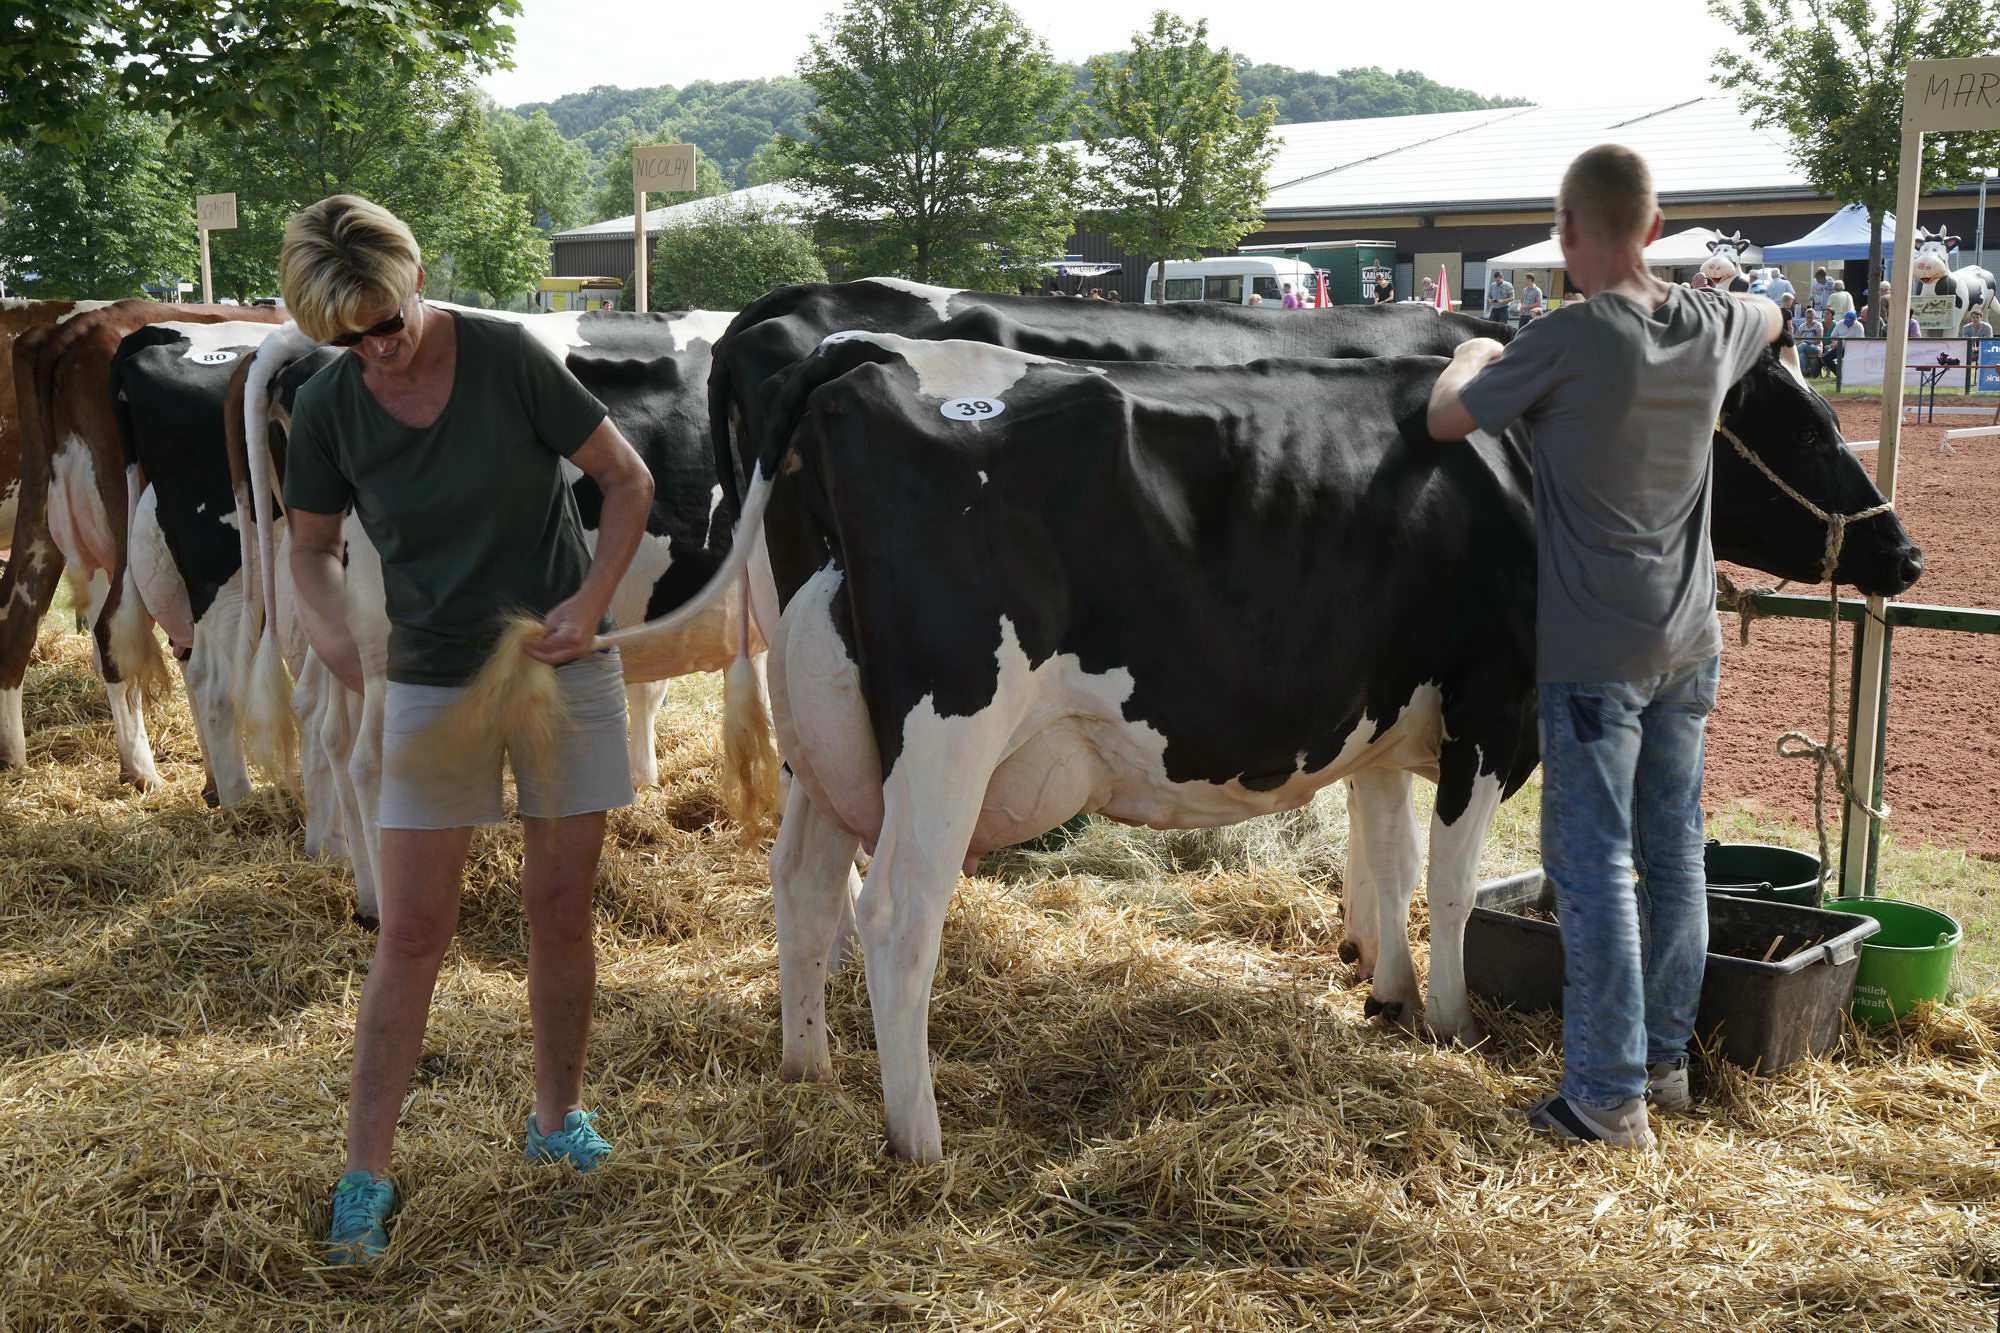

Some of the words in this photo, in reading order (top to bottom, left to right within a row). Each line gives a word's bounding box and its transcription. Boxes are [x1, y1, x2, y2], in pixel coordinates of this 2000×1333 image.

[1924, 72, 2000, 110] MAR
[636, 157, 689, 189] NICOLAY
[956, 401, 993, 416] 39
